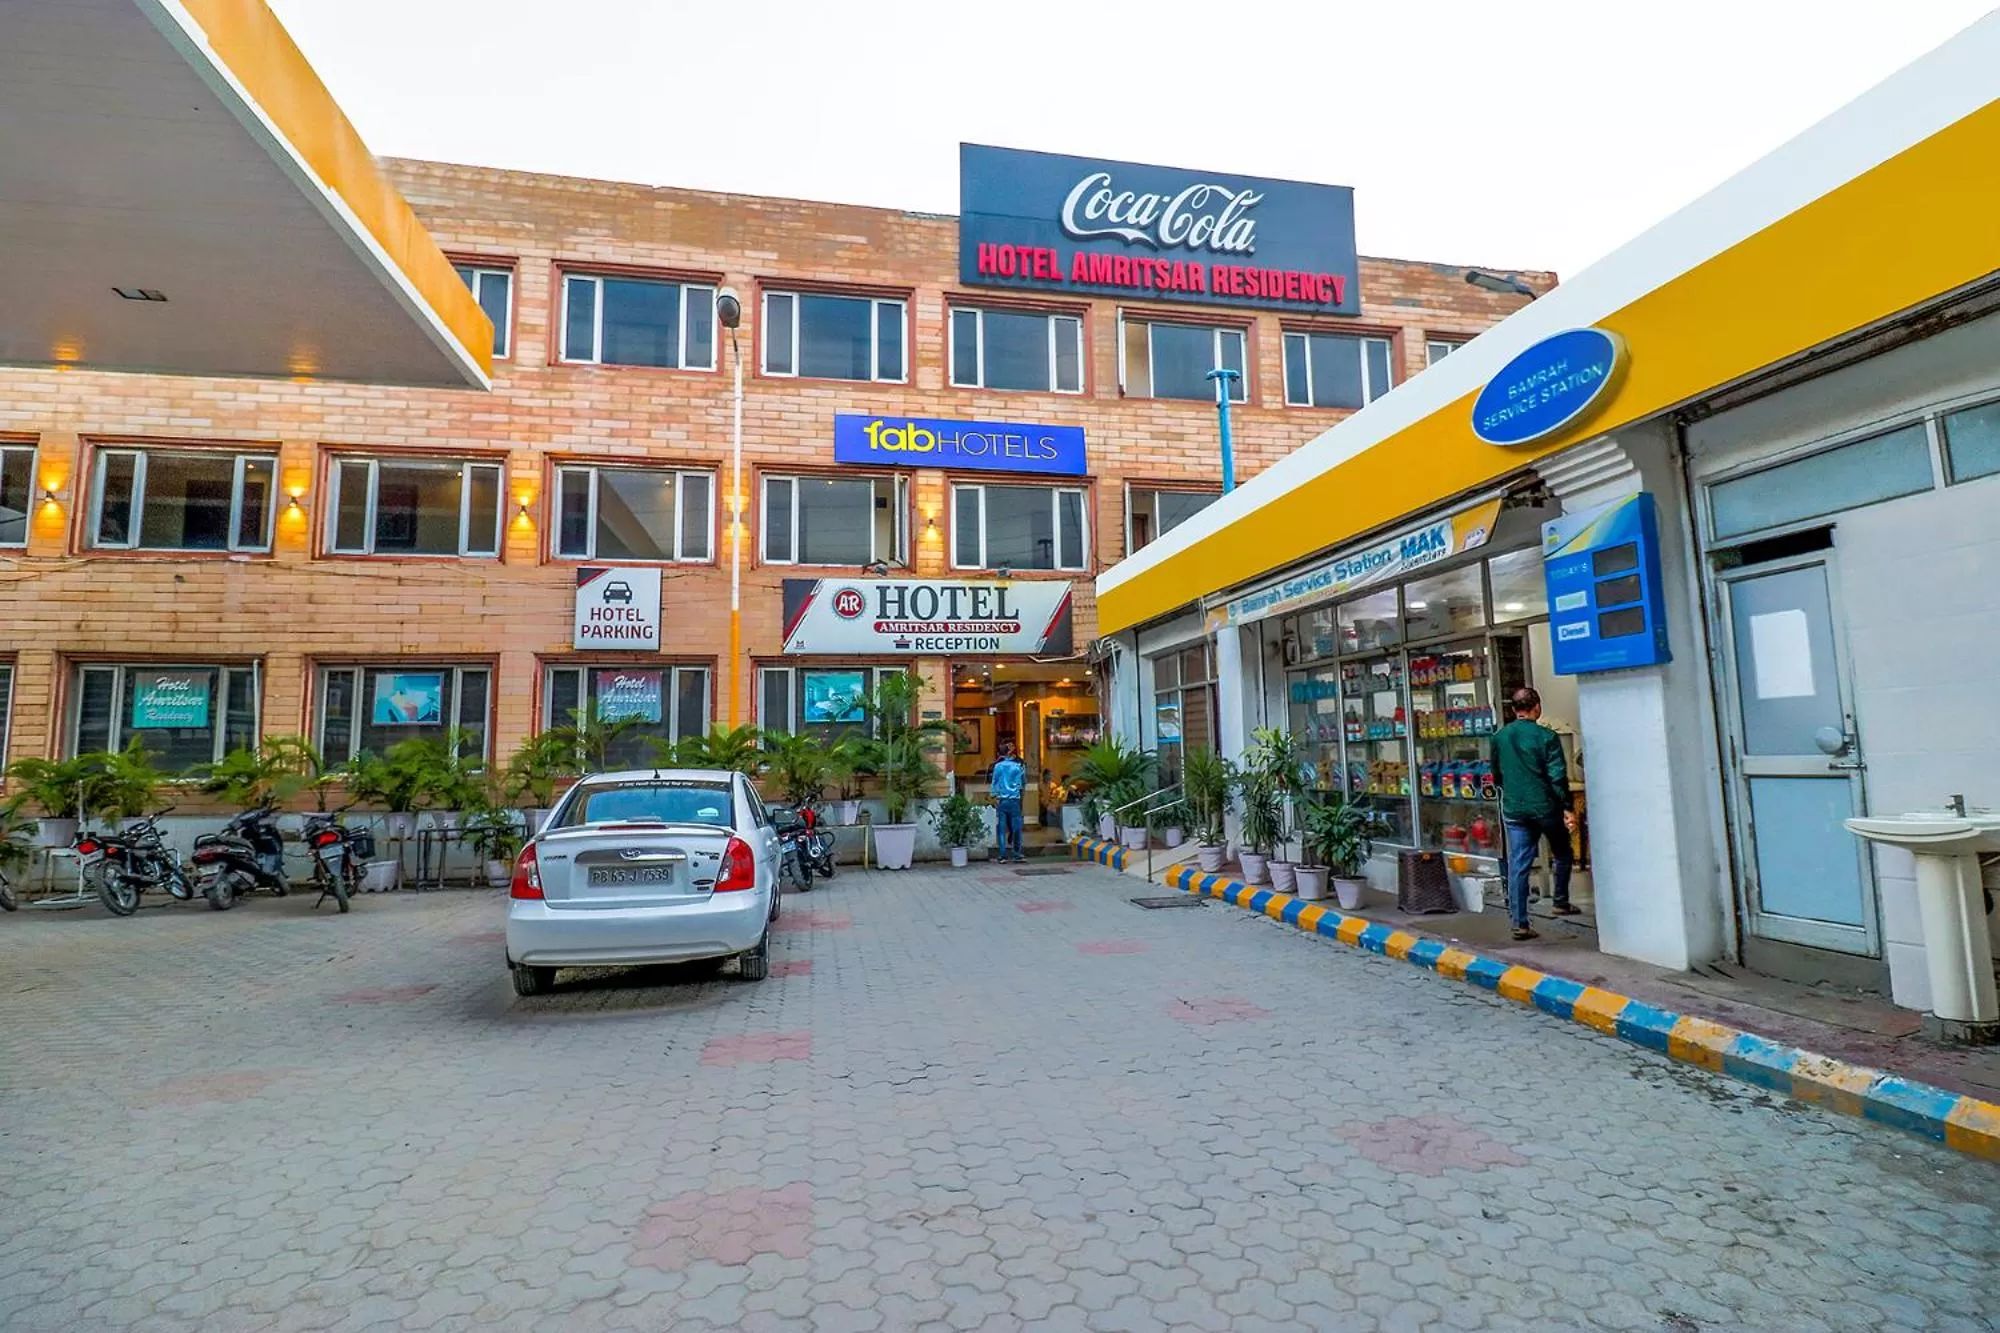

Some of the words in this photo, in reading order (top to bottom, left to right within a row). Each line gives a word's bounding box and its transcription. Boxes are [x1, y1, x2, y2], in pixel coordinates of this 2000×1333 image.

[978, 243, 1063, 281] HOTEL
[1071, 250, 1206, 294] AMRITSAR
[1212, 264, 1347, 305] RESIDENCY
[1507, 358, 1569, 399] BAMRAH
[1482, 394, 1537, 431] SERVICE
[1541, 362, 1603, 403] STATION
[1400, 524, 1446, 559] MAK
[1241, 587, 1281, 614] Bamrah
[1283, 571, 1331, 597] Service
[1334, 548, 1393, 580] Station
[838, 594, 860, 612] AR
[875, 585, 1020, 620] HOTEL
[590, 607, 645, 621] HOTEL
[581, 624, 653, 639] PARKING
[879, 622, 945, 633] AMRITSAR
[948, 622, 1017, 633] RESIDENCY
[915, 637, 1000, 650] RECEPTION
[156, 676, 191, 690] Hotel
[614, 675, 646, 689] Hotel
